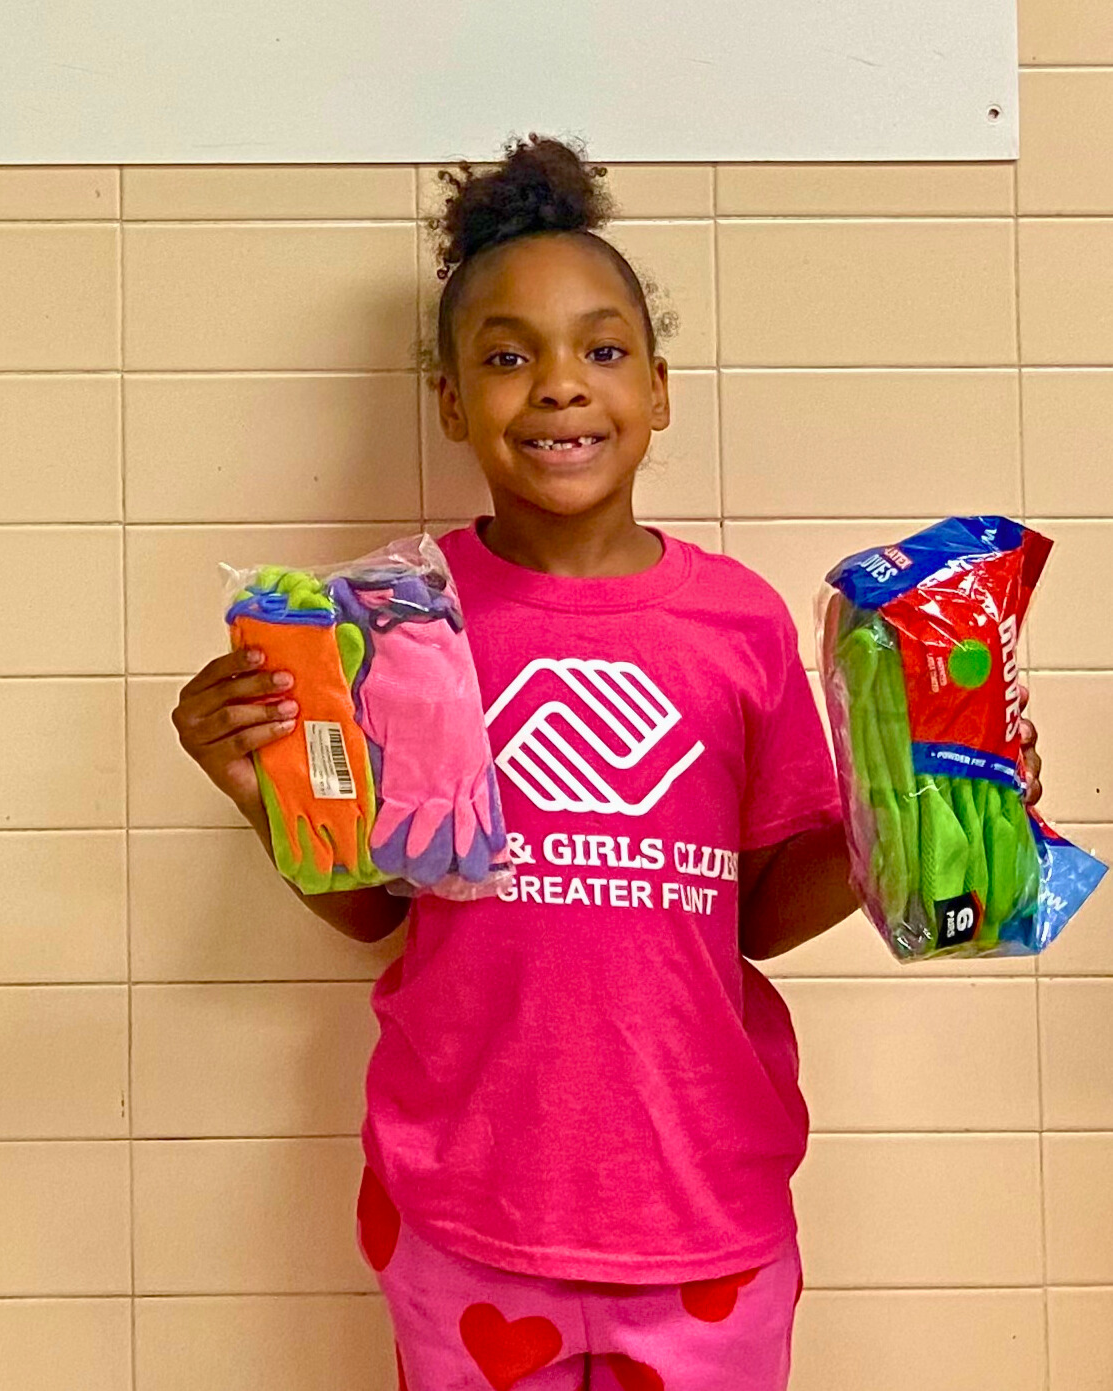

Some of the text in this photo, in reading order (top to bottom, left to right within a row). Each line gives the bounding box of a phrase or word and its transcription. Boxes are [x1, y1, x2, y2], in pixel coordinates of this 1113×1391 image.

[997, 613, 1021, 743] GLOVES
[504, 832, 537, 866] &
[542, 832, 666, 871] GIRLS
[496, 874, 655, 910] GREATER
[955, 906, 975, 932] 6
